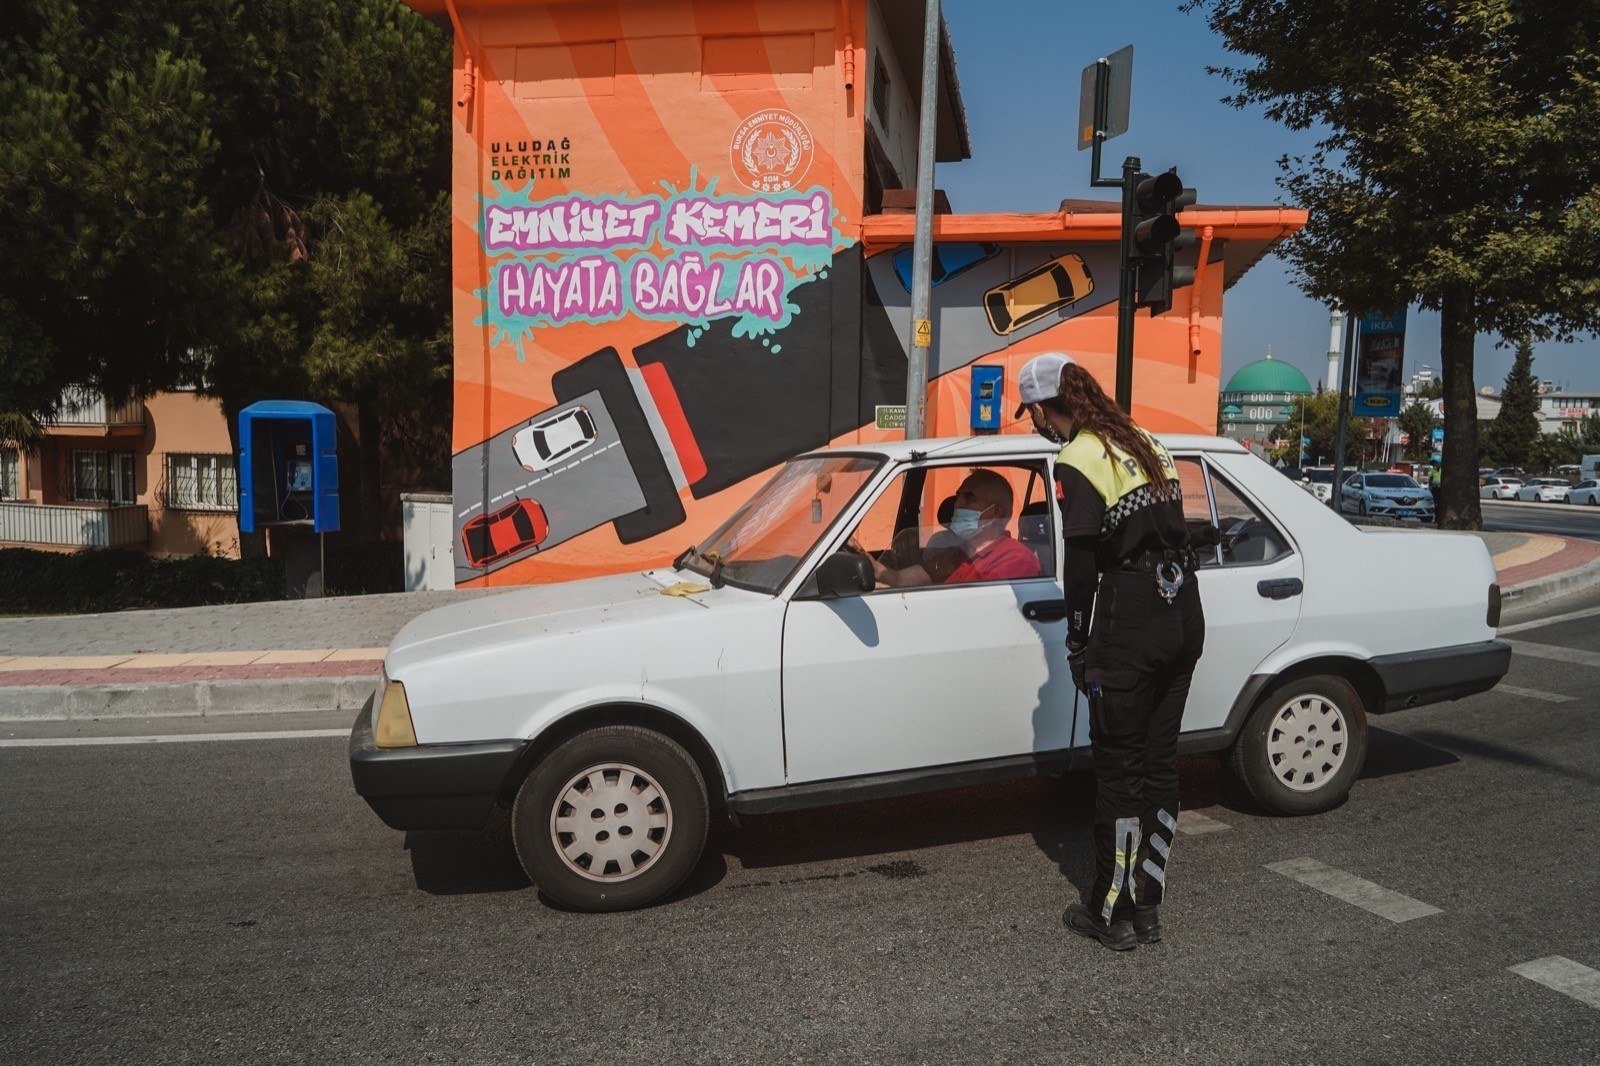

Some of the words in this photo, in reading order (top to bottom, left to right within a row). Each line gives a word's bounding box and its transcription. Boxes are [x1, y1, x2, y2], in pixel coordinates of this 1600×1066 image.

[733, 126, 750, 150] BURSA
[747, 113, 779, 128] EMNİYET
[778, 114, 811, 151] MÜDÜRLÜĞÜ
[491, 137, 570, 153] ULUDAĞ
[491, 151, 570, 167] ELEKTRİK
[491, 166, 570, 181] DAĞITIM
[503, 260, 617, 317] HAYATA
[635, 256, 779, 316] BAĞLAR
[1370, 321, 1394, 330] IKEA
